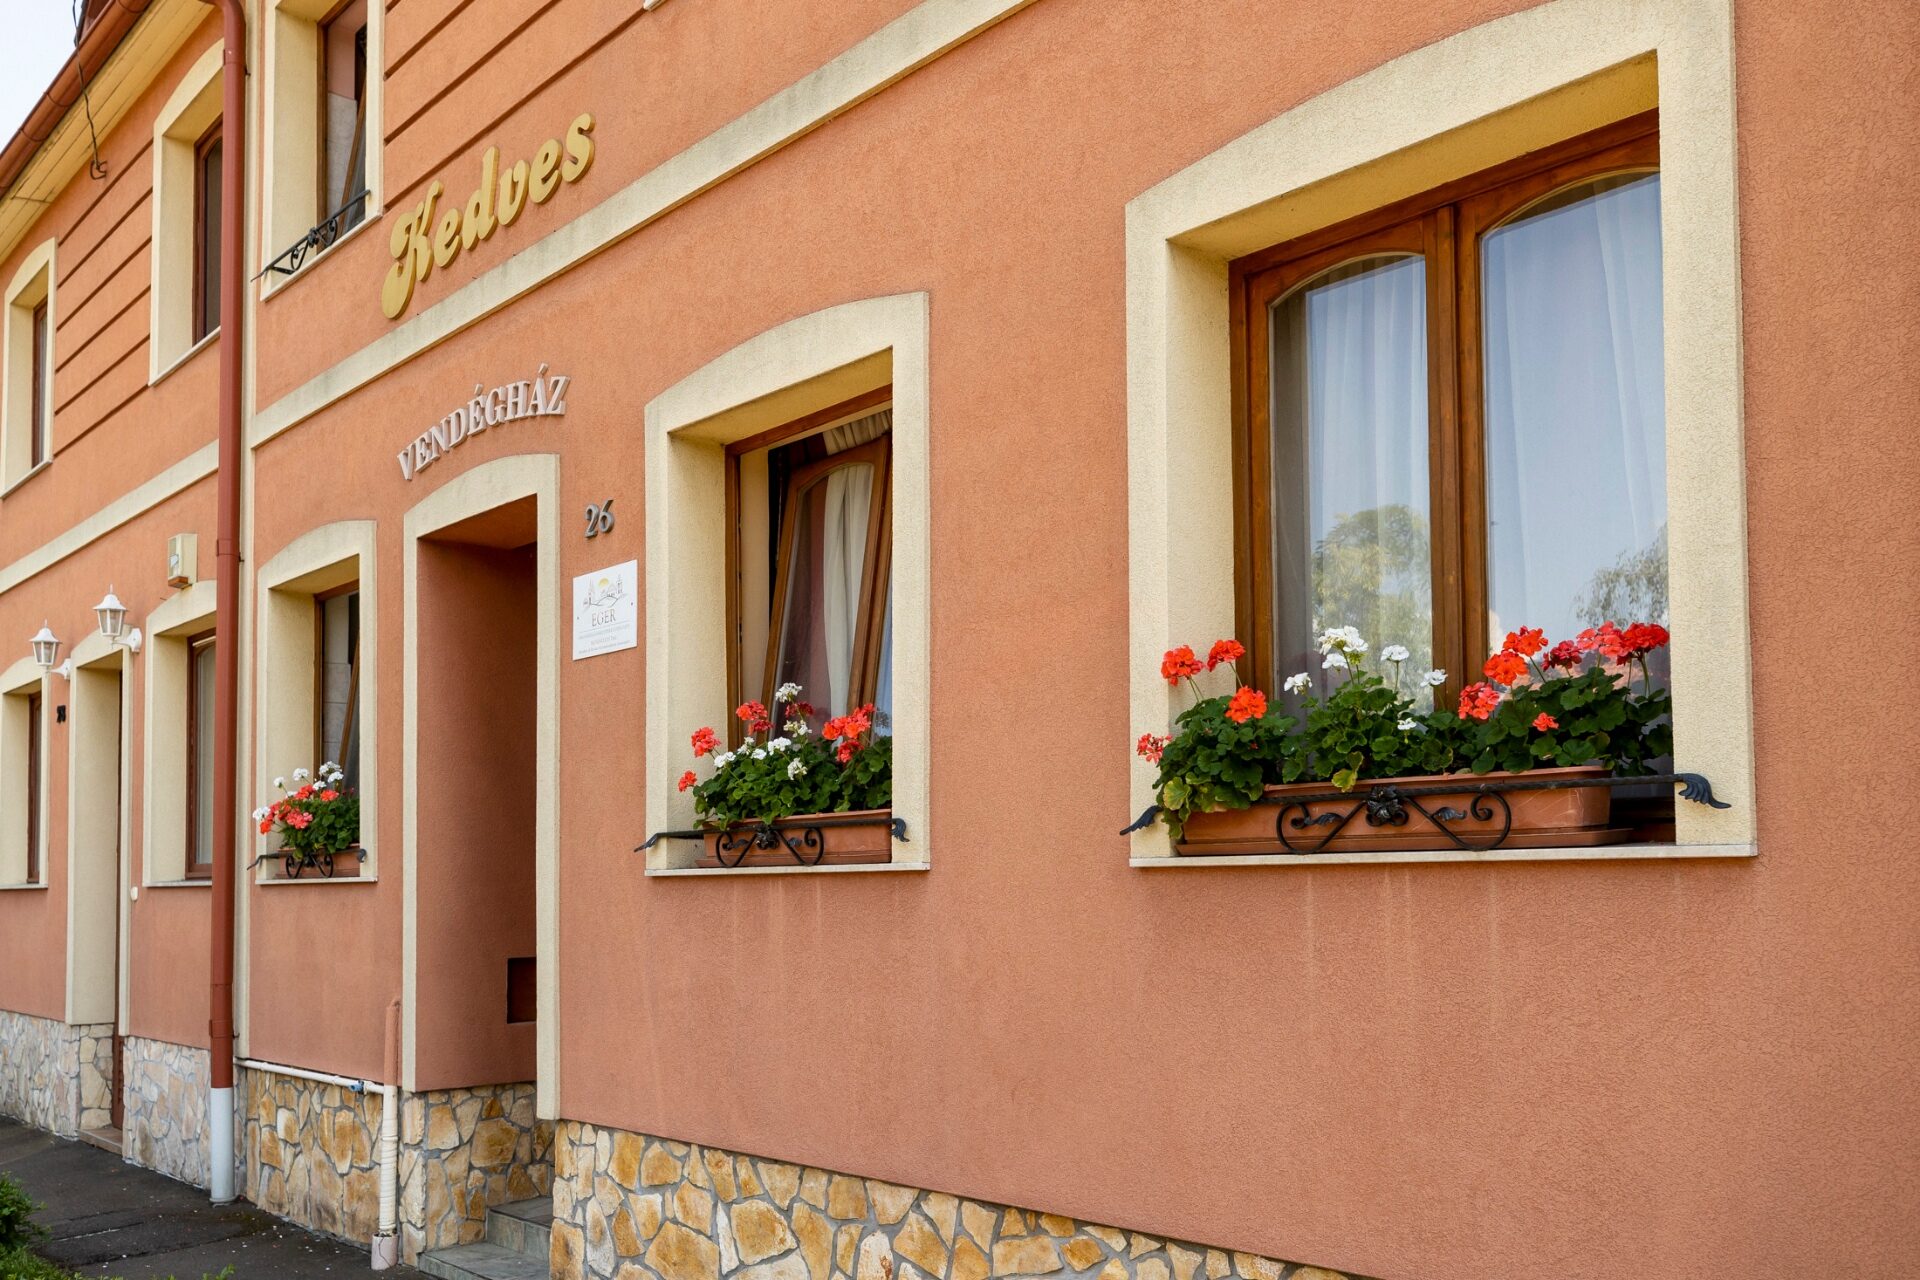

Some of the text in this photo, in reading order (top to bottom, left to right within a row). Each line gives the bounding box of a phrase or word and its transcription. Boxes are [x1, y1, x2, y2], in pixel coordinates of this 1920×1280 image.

[381, 112, 596, 320] Kedves
[396, 363, 571, 481] VENDÉGHÁZ
[585, 498, 615, 539] 26
[591, 608, 616, 627] EGER
